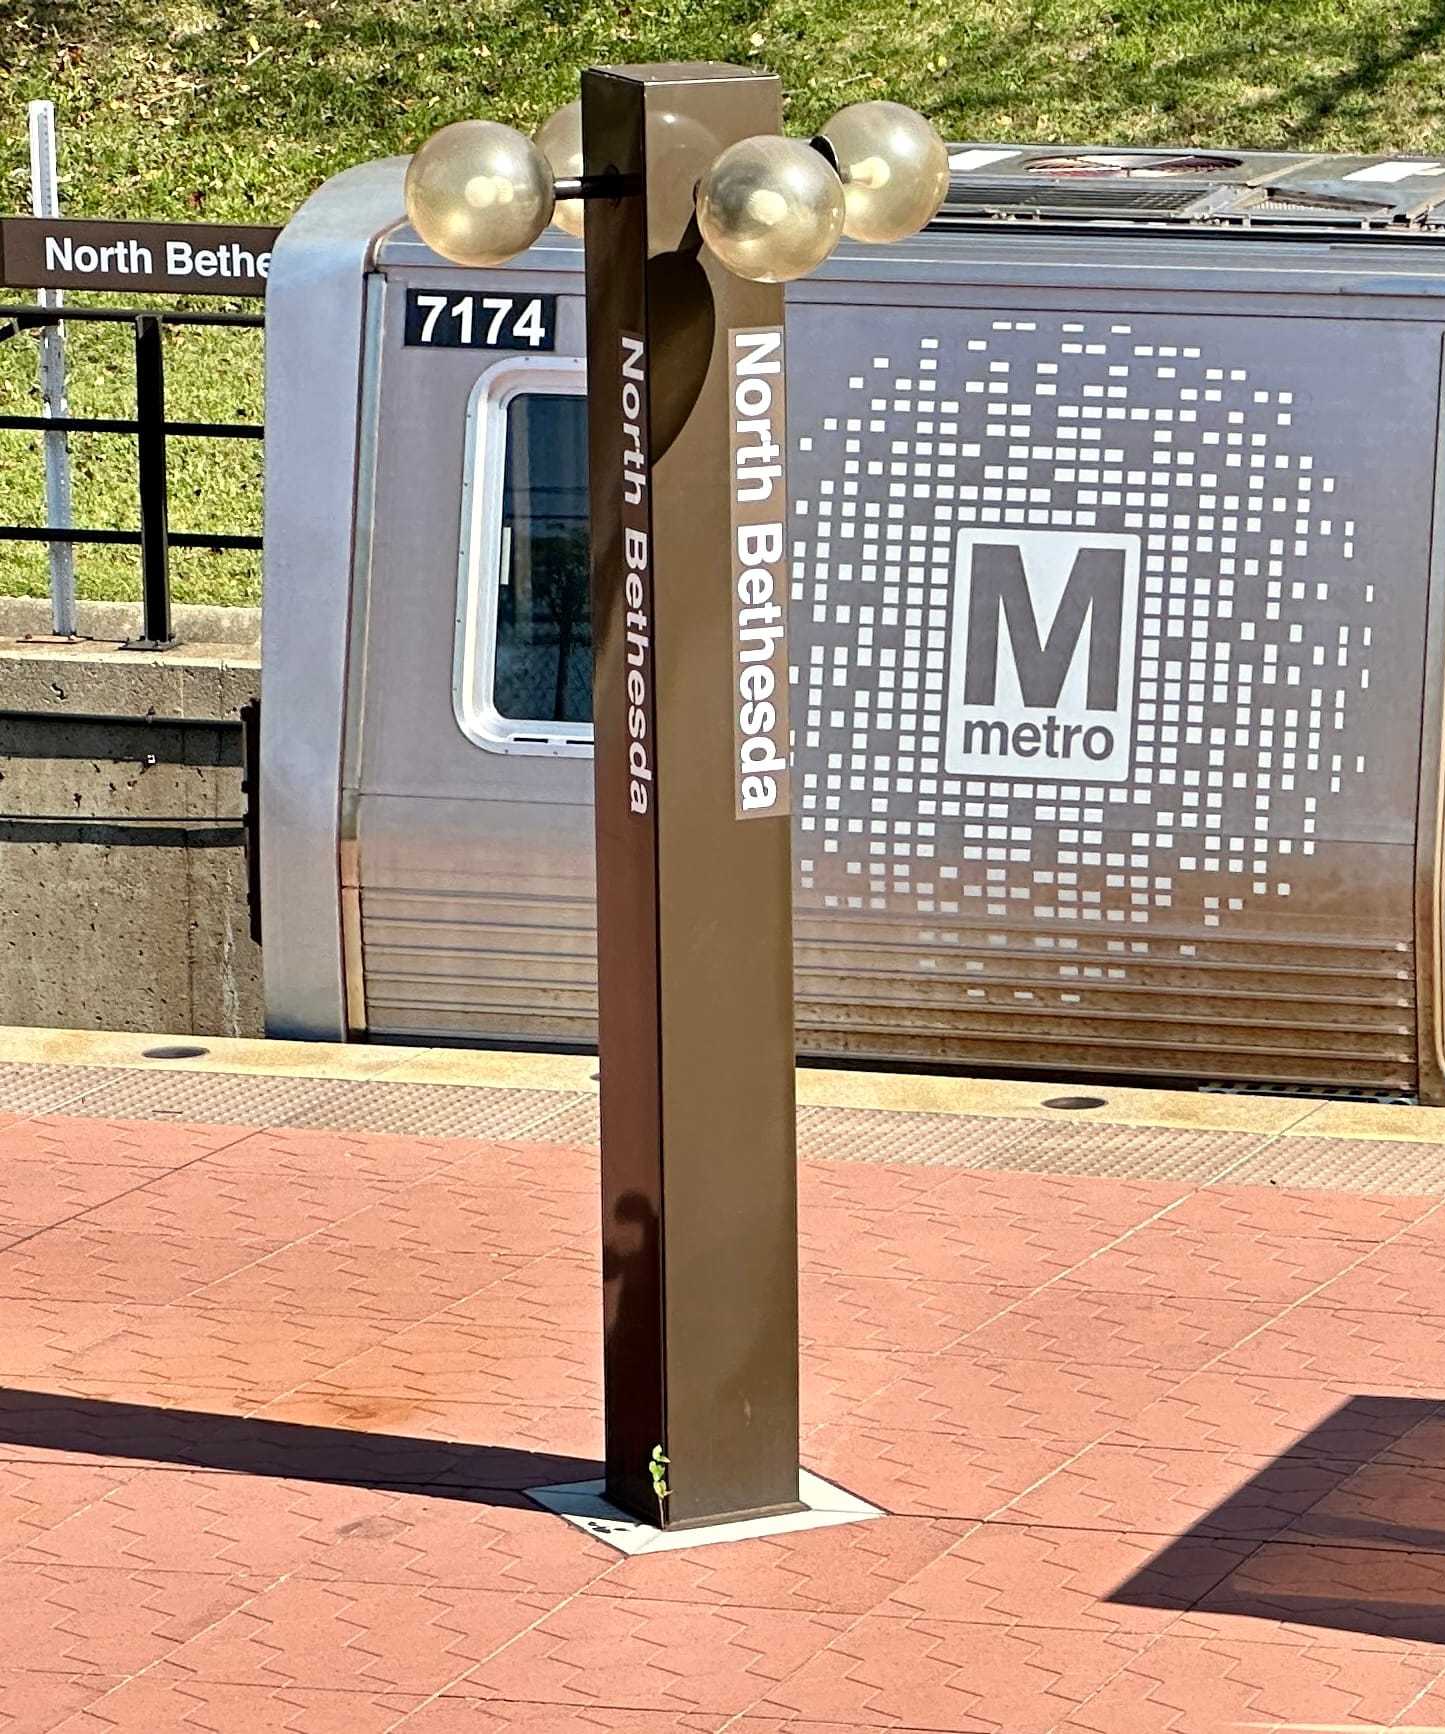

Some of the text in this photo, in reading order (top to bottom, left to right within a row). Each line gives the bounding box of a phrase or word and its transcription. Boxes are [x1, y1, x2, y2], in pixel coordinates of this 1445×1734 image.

[45, 237, 153, 275] North
[416, 296, 546, 347] 7174
[620, 336, 652, 815] North Bethesda
[735, 332, 786, 811] North Bethesda
[963, 543, 1126, 712] M
[962, 715, 1114, 761] metro
